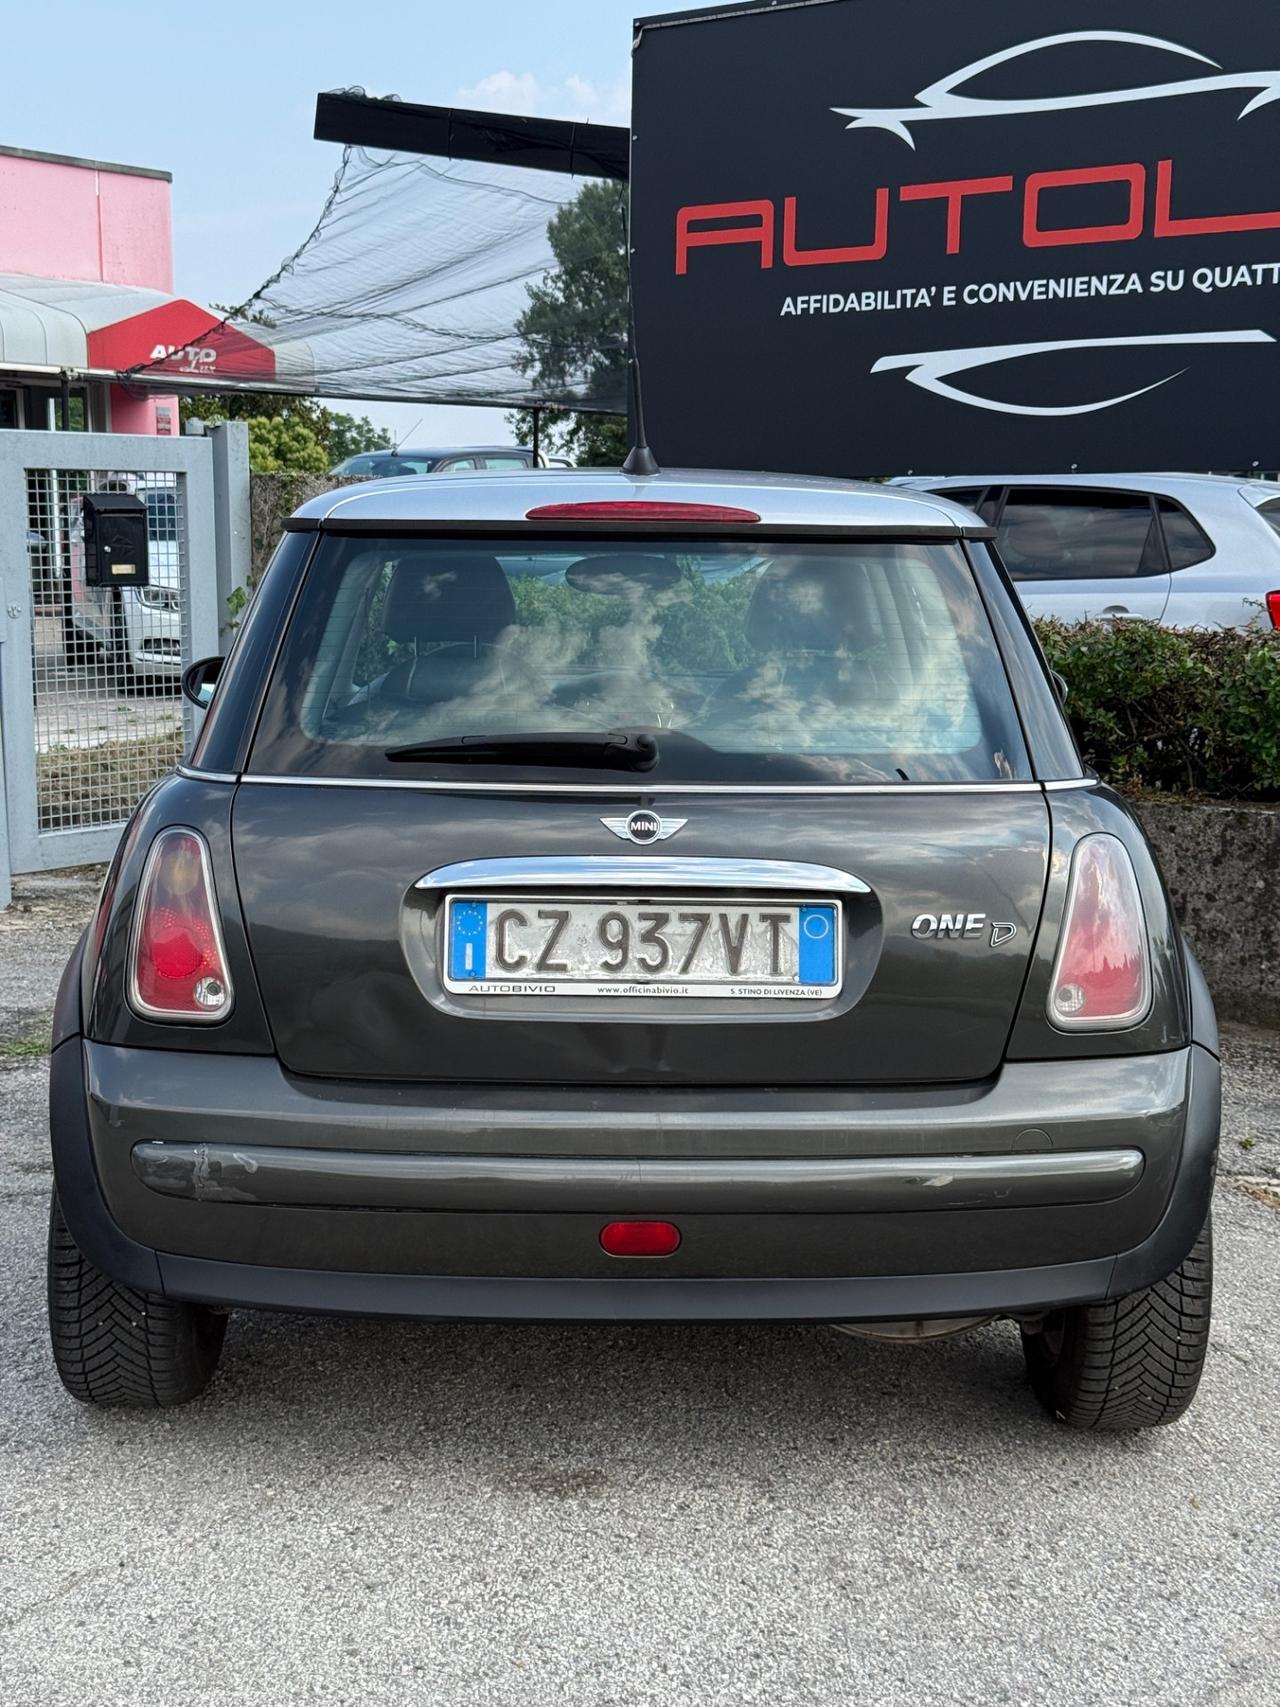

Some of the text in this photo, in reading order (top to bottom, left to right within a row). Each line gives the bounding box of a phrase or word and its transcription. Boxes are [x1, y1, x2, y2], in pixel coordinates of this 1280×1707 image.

[675, 159, 1280, 275] AUTOL
[942, 283, 957, 307] E
[962, 270, 1143, 305] CONVENIENZA
[1149, 269, 1185, 293] SU
[1192, 262, 1280, 294] QUATT
[149, 344, 217, 363] AUTO
[630, 821, 658, 832] MINI
[911, 913, 1017, 948] ONE D
[494, 907, 793, 977] CZ 937VT
[468, 984, 556, 994] AUTOBIVIO
[597, 985, 689, 996] www.officinabivio.it
[738, 987, 762, 996] STINO
[763, 988, 772, 996] DI
[773, 988, 806, 997] LIVENZA
[807, 989, 823, 997] (VE)
